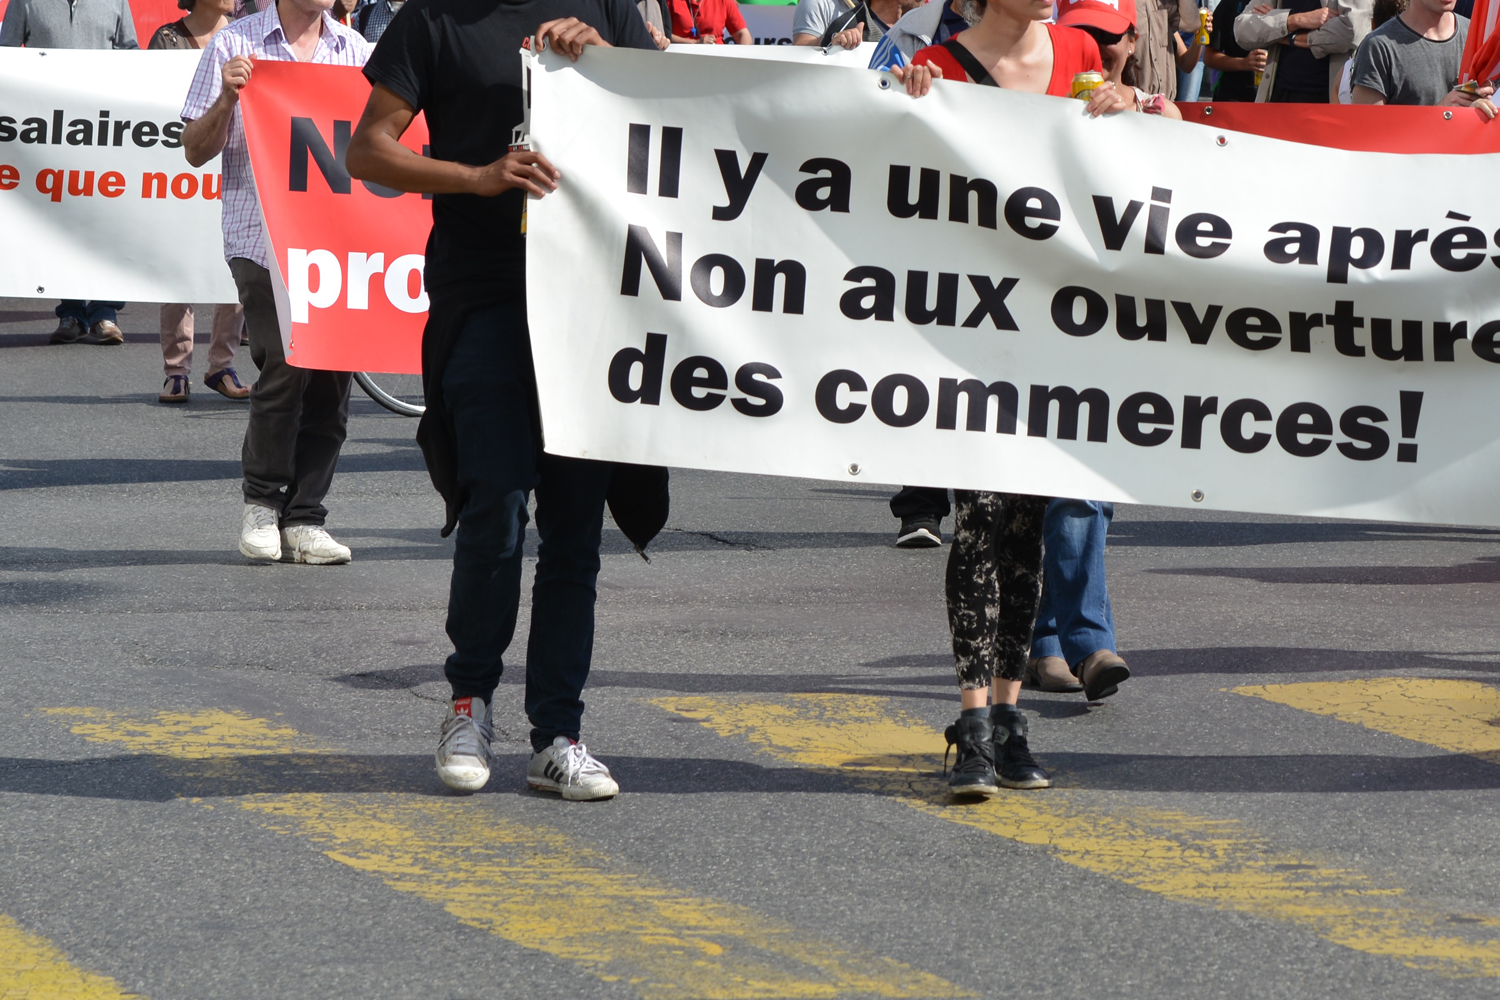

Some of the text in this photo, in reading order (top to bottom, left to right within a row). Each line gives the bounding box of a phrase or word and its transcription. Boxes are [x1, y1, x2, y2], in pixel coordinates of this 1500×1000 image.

[35, 167, 126, 203] que
[626, 122, 684, 199] Il
[711, 148, 769, 222] y
[794, 157, 852, 214] a
[886, 164, 1062, 241] une
[1090, 185, 1234, 259] vie
[620, 223, 807, 316] Non
[838, 264, 1021, 332] aux
[607, 331, 1425, 464] des commerces!
